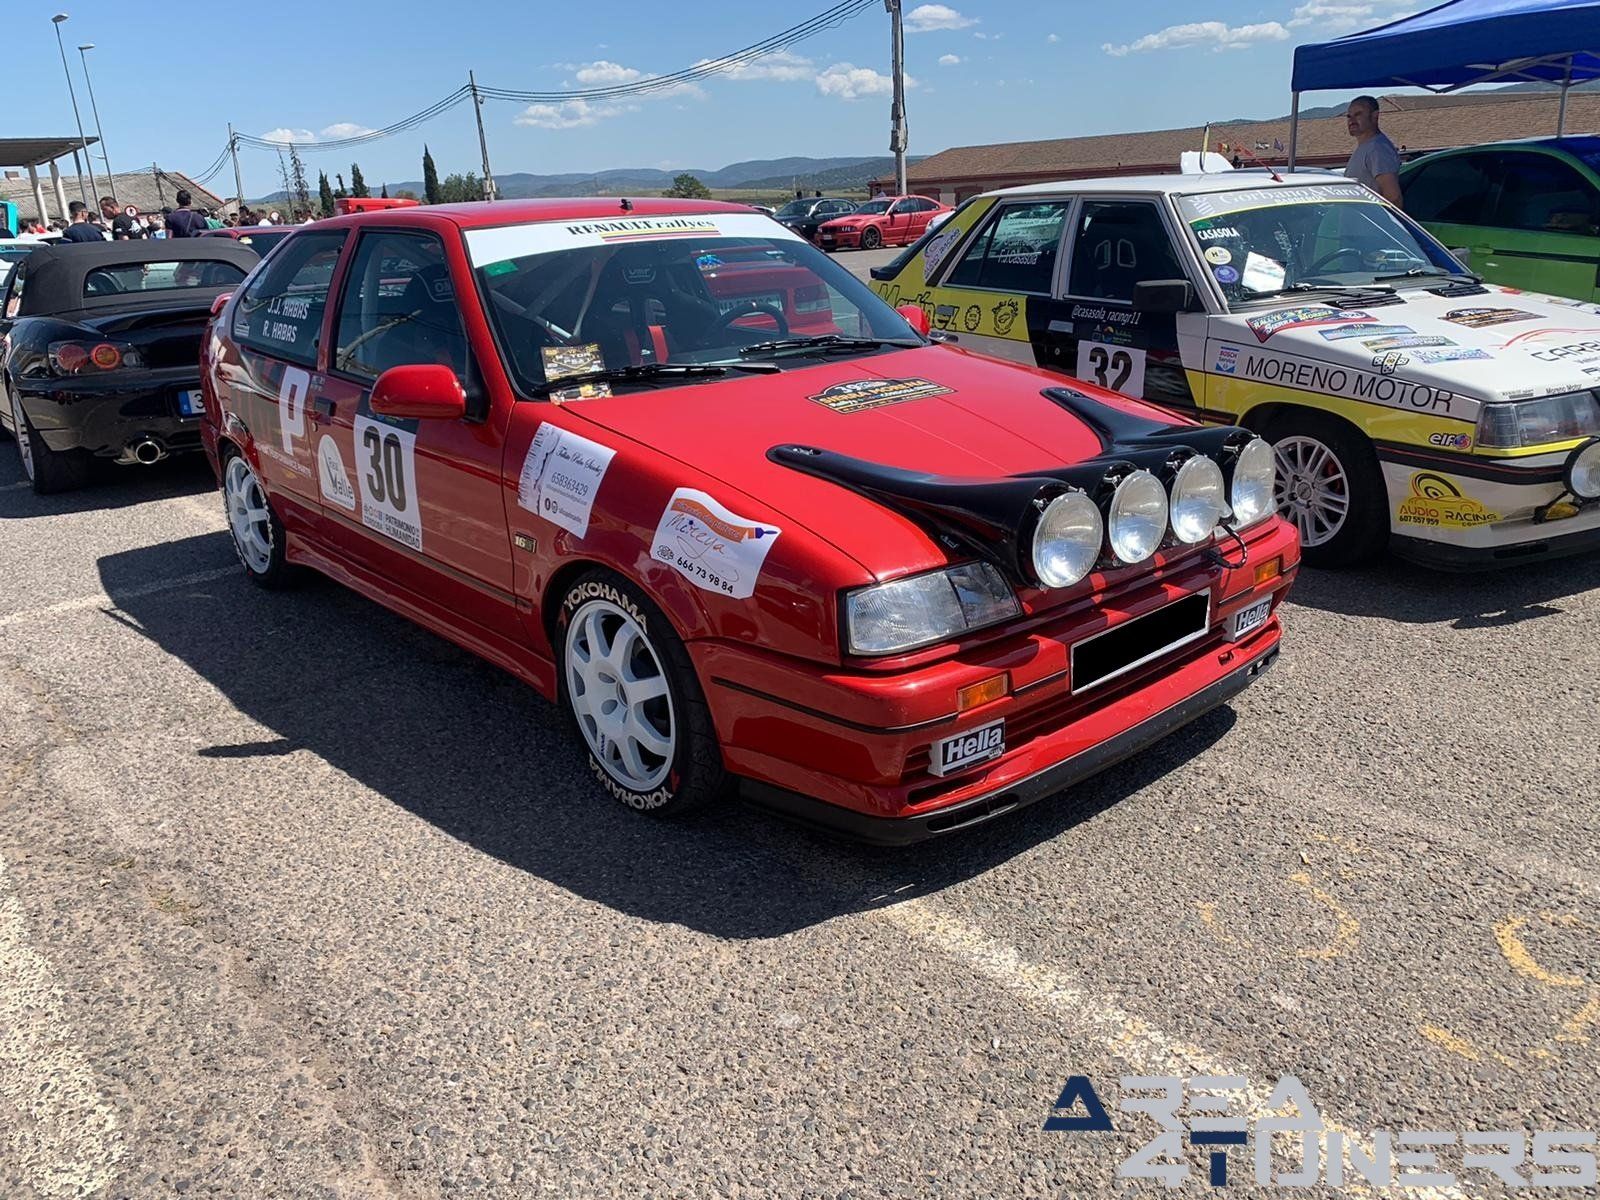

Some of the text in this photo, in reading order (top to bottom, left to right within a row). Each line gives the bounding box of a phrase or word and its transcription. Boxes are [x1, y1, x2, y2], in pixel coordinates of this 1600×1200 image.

[567, 218, 716, 235] RENAULT rallyes
[1197, 227, 1241, 241] CASASOLA
[267, 297, 310, 320] J.J. HABAS
[262, 320, 270, 338] R.
[271, 322, 298, 343] HABAS
[1220, 350, 1238, 358] BOSCH
[1531, 340, 1600, 361] CARB
[1088, 346, 1133, 393] 32
[1245, 355, 1453, 412] MORENO MOTOR
[1428, 433, 1457, 447] elf
[364, 425, 406, 512] 30
[551, 472, 589, 497] 658363429
[1400, 504, 1497, 521] AUDIO RACING
[677, 556, 734, 594] 666 73 98 84
[563, 582, 648, 635] YOKOHAMA
[1238, 603, 1270, 631] Hella
[946, 727, 1002, 763] Hella
[589, 753, 674, 811] YOKOHAMA
